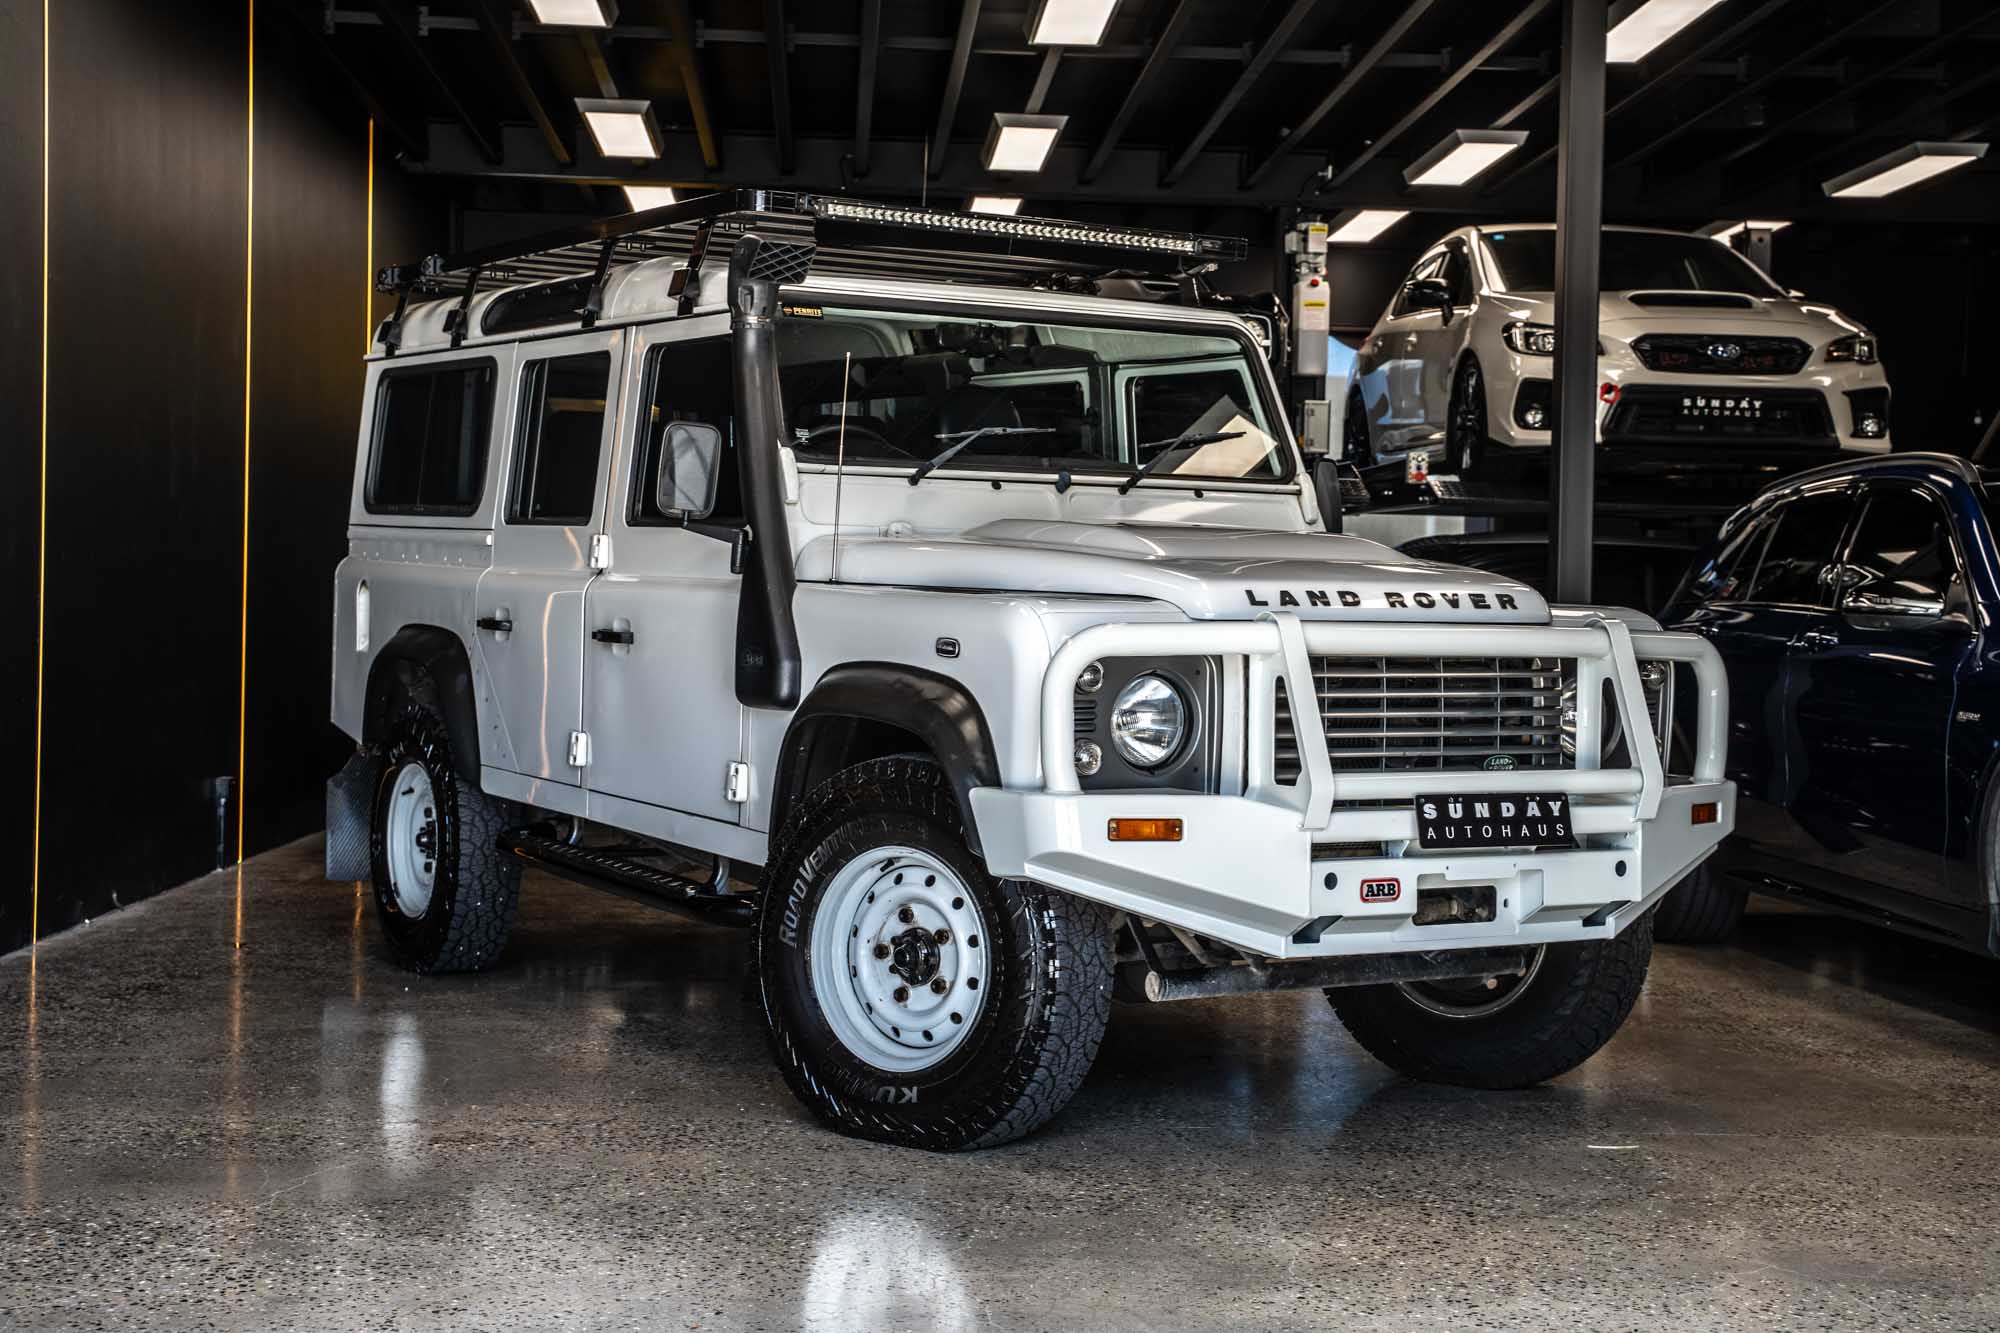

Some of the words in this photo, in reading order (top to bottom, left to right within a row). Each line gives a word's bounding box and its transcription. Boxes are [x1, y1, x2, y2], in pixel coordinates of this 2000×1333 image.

[1682, 408, 1761, 417] AUTOHAUS
[1245, 590, 1361, 607] LAND
[1384, 592, 1518, 610] ROVER
[1427, 824, 1565, 839] AUTOHAUS
[1365, 883, 1396, 898] ARB
[779, 878, 808, 949] ROAD
